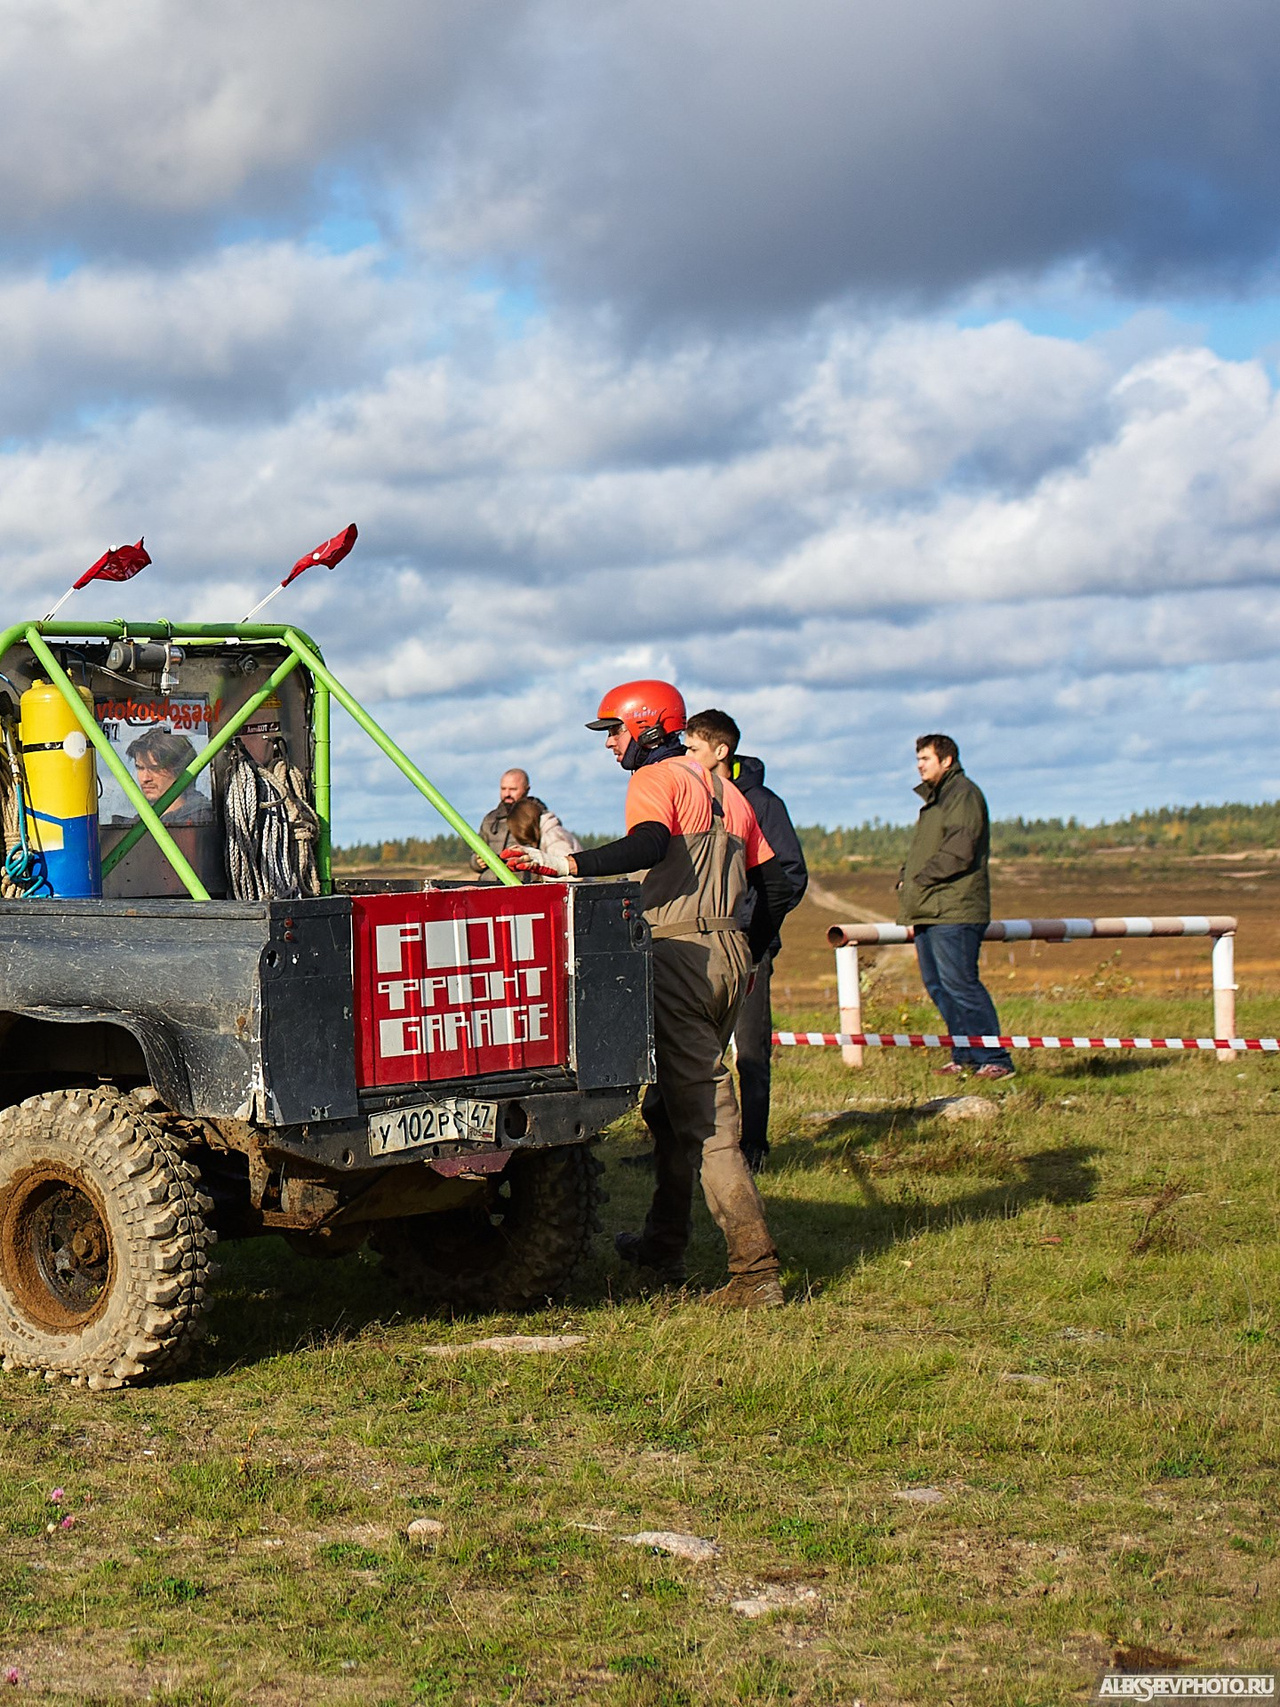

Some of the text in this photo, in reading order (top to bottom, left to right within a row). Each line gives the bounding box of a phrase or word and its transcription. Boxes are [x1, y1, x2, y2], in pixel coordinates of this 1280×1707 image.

[96, 696, 223, 723] vtokotdosaaf
[379, 1003, 549, 1058] GARAGE
[471, 1103, 490, 1128] 47
